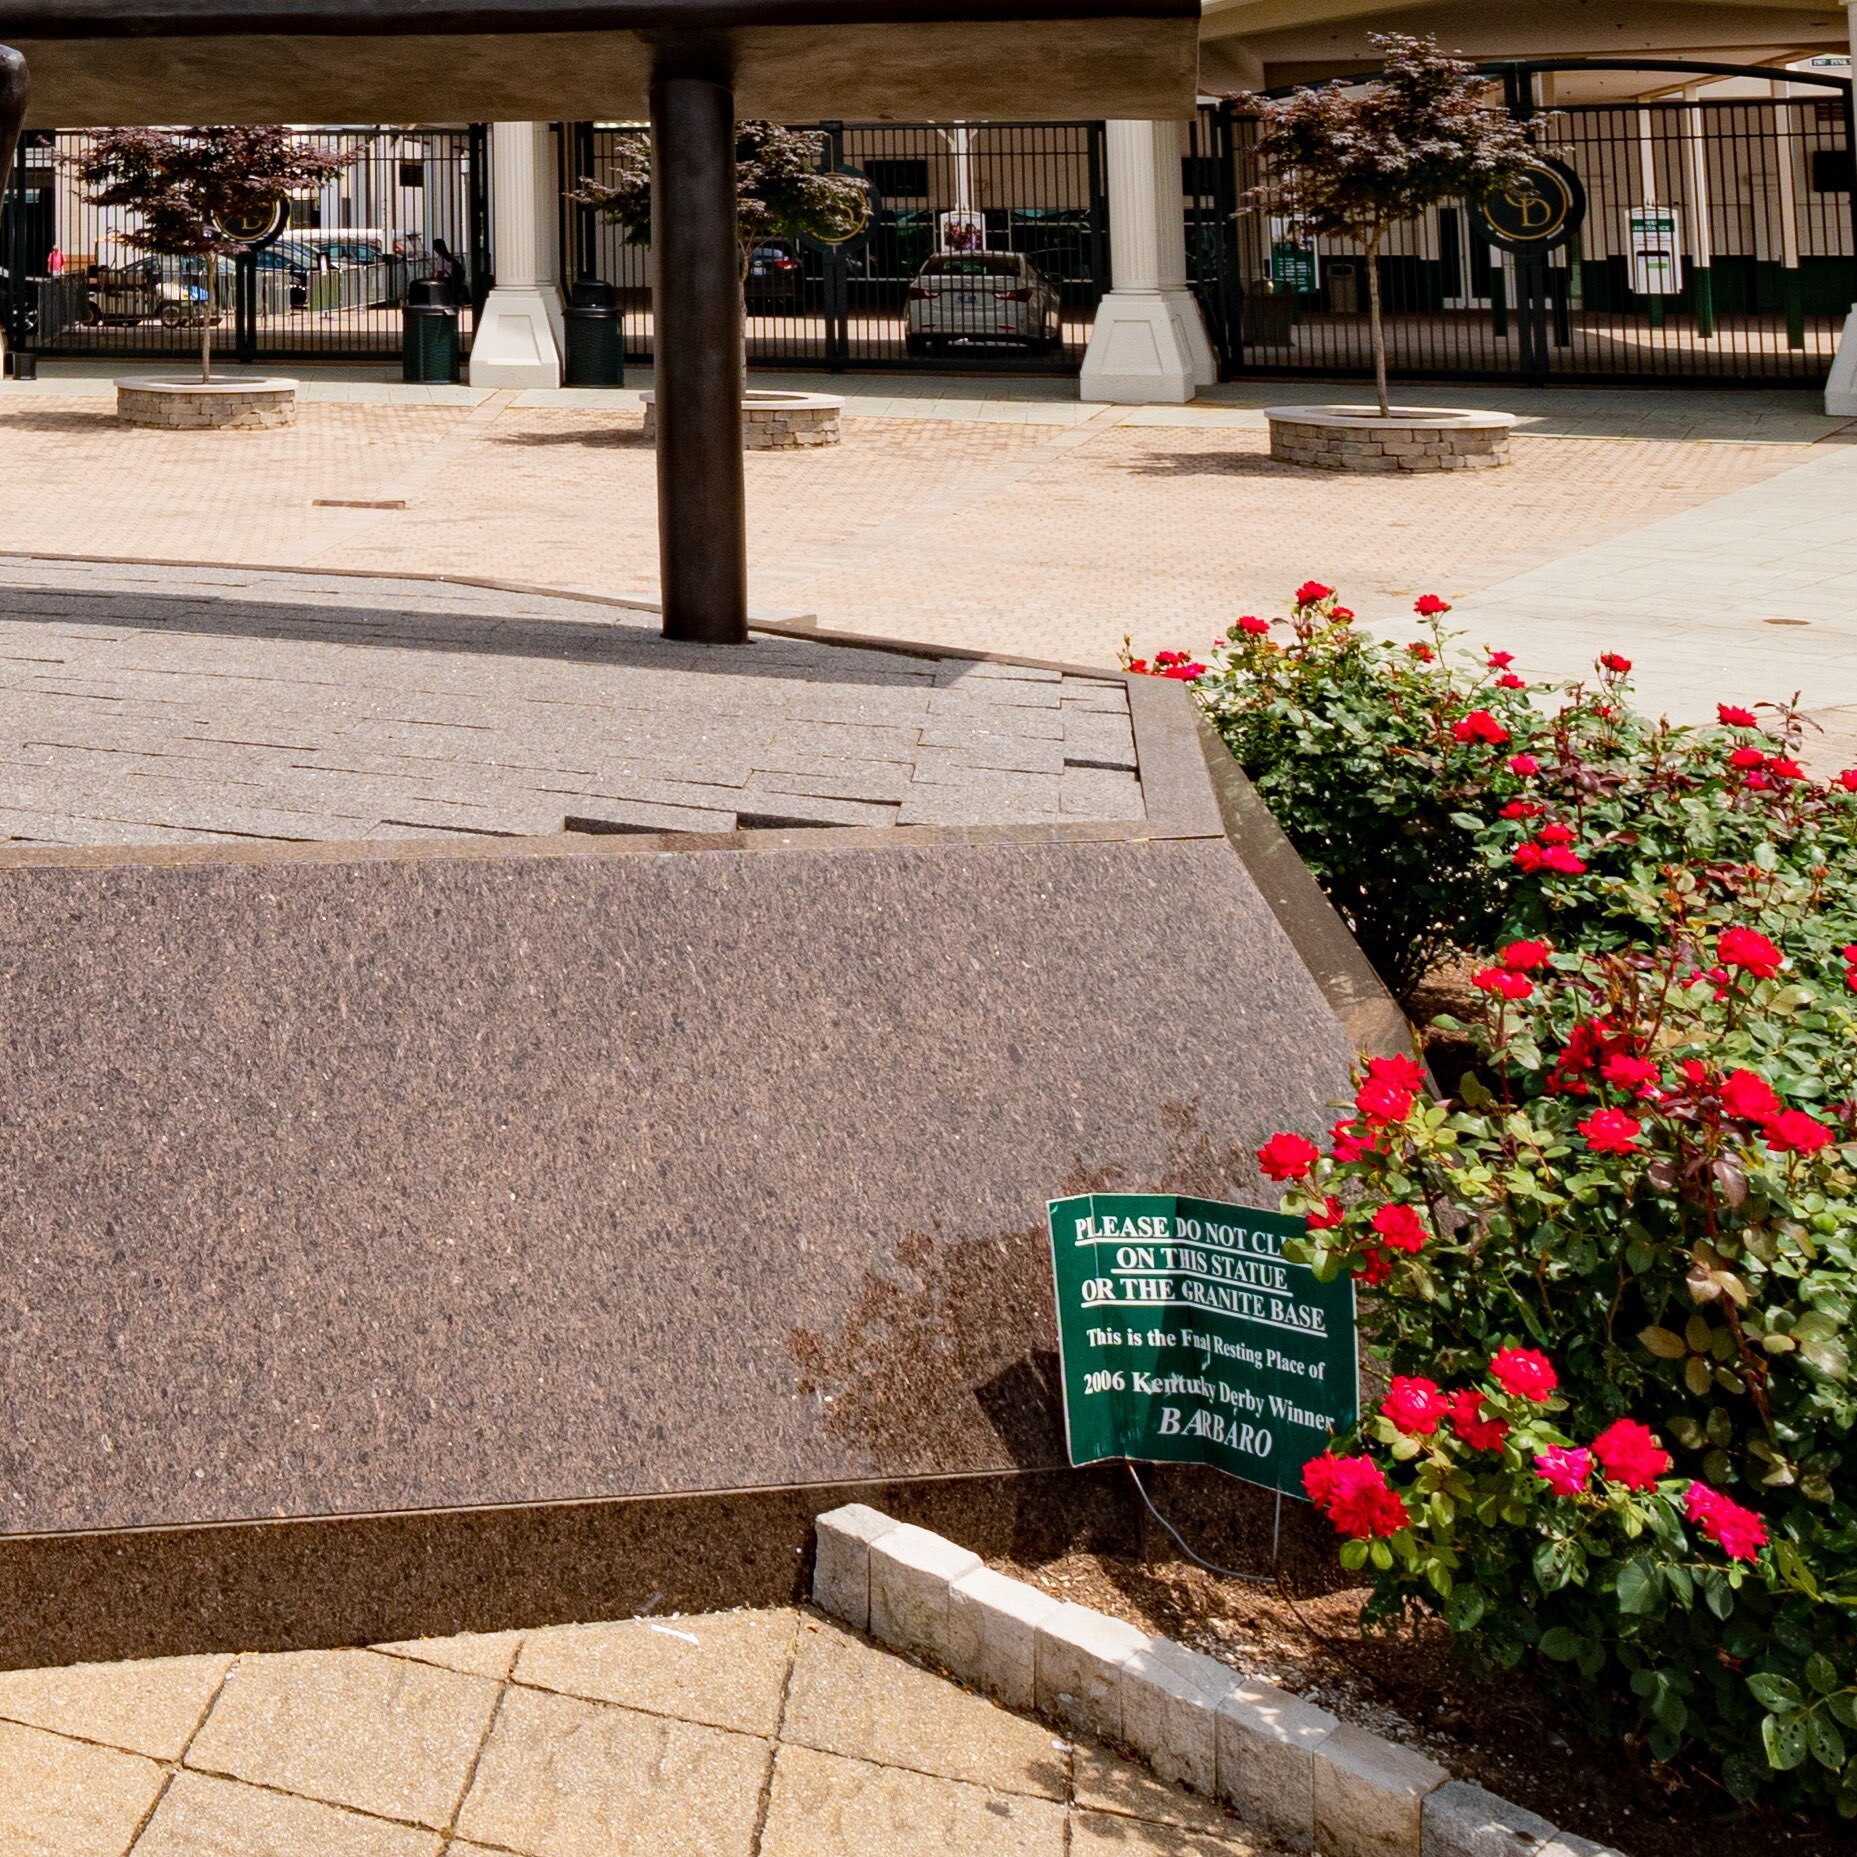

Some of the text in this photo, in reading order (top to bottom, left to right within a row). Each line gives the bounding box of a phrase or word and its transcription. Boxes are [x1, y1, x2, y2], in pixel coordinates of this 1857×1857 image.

[1074, 1216, 1170, 1240] PLEASE
[1175, 1217, 1201, 1241] DO
[1205, 1222, 1247, 1250] NOT
[1116, 1247, 1288, 1290] ON THIS STATUE
[1081, 1278, 1326, 1331] OR THE GRANITE BASE
[1086, 1327, 1123, 1347] This
[1127, 1328, 1143, 1347] is
[1147, 1329, 1176, 1347] the
[1213, 1334, 1263, 1370] Resting
[1266, 1348, 1305, 1376] Place
[1308, 1361, 1326, 1380] of
[1084, 1370, 1126, 1395] 2006
[1219, 1381, 1265, 1419] Derby
[1268, 1394, 1335, 1432] Winner
[1156, 1406, 1273, 1458] BARBARO
